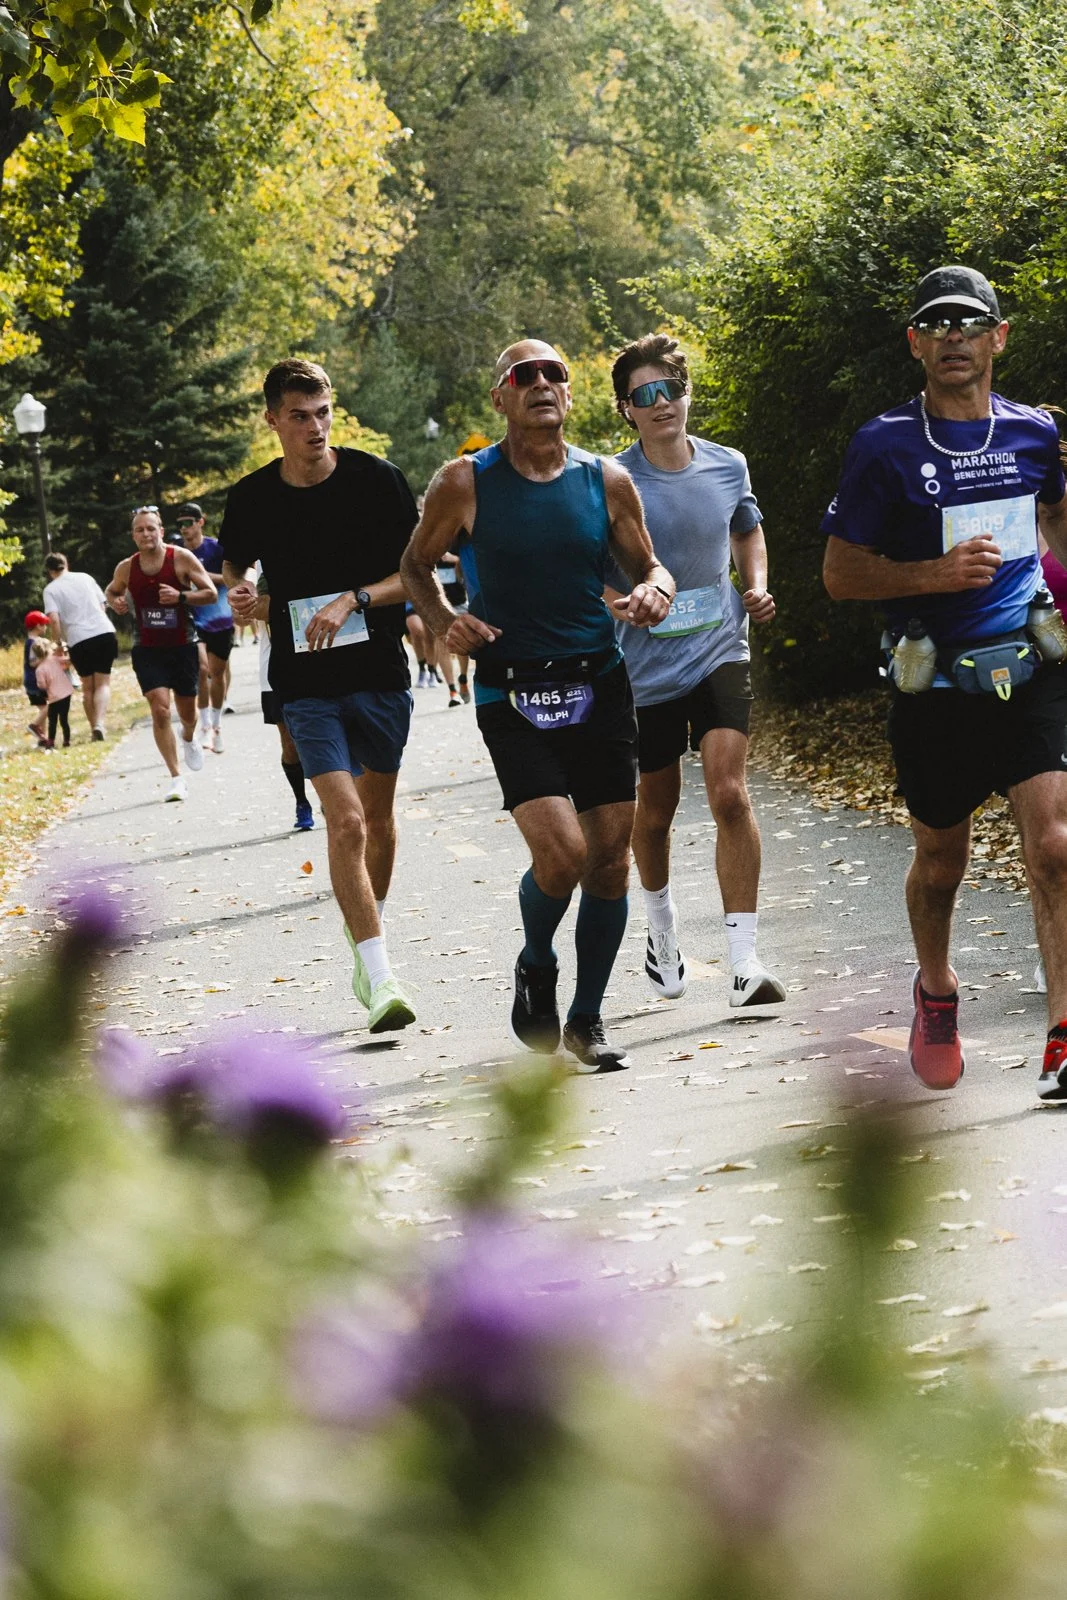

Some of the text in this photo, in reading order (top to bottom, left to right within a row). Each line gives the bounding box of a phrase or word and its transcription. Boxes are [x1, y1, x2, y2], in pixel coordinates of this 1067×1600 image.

[951, 452, 1016, 470] MARATHON
[954, 464, 1019, 481] BENEVA QUÉBEC
[958, 513, 1004, 535] 5809
[147, 611, 161, 619] 740
[670, 617, 704, 630] WILLIAM
[520, 690, 561, 706] 1465
[536, 710, 569, 722] RALPH
